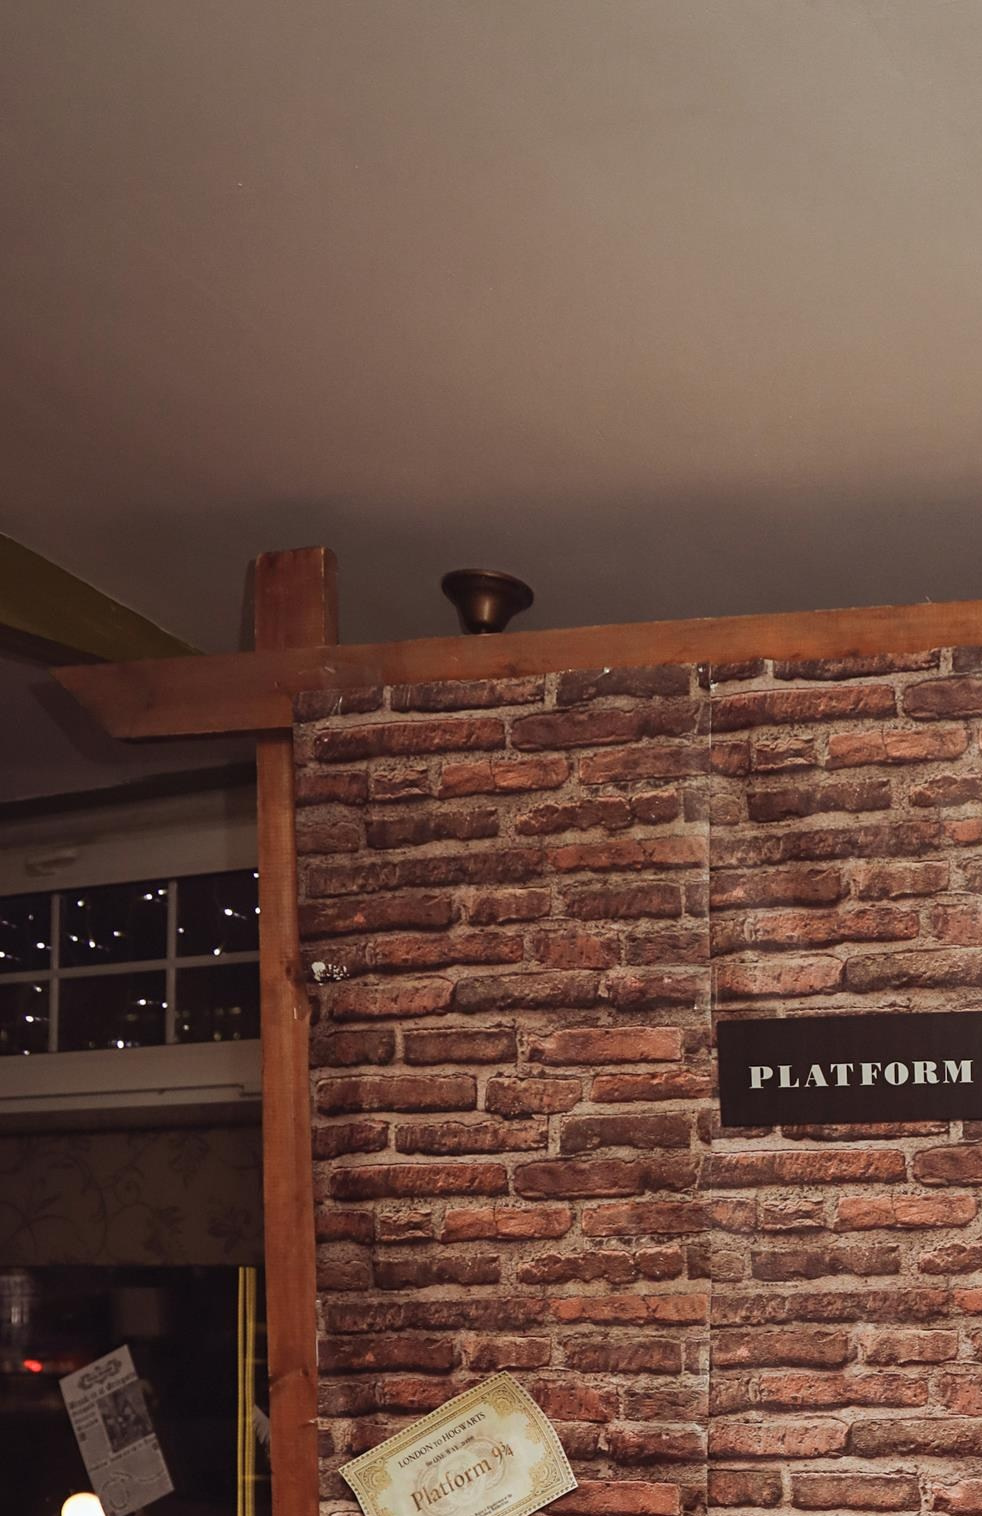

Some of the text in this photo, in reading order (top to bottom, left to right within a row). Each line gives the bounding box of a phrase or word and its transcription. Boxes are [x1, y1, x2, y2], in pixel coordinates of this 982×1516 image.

[748, 1059, 974, 1089] PLATFORM
[398, 1443, 433, 1469] LONDON
[442, 1411, 487, 1441] HOGWARTS
[410, 1457, 493, 1512] Platform
